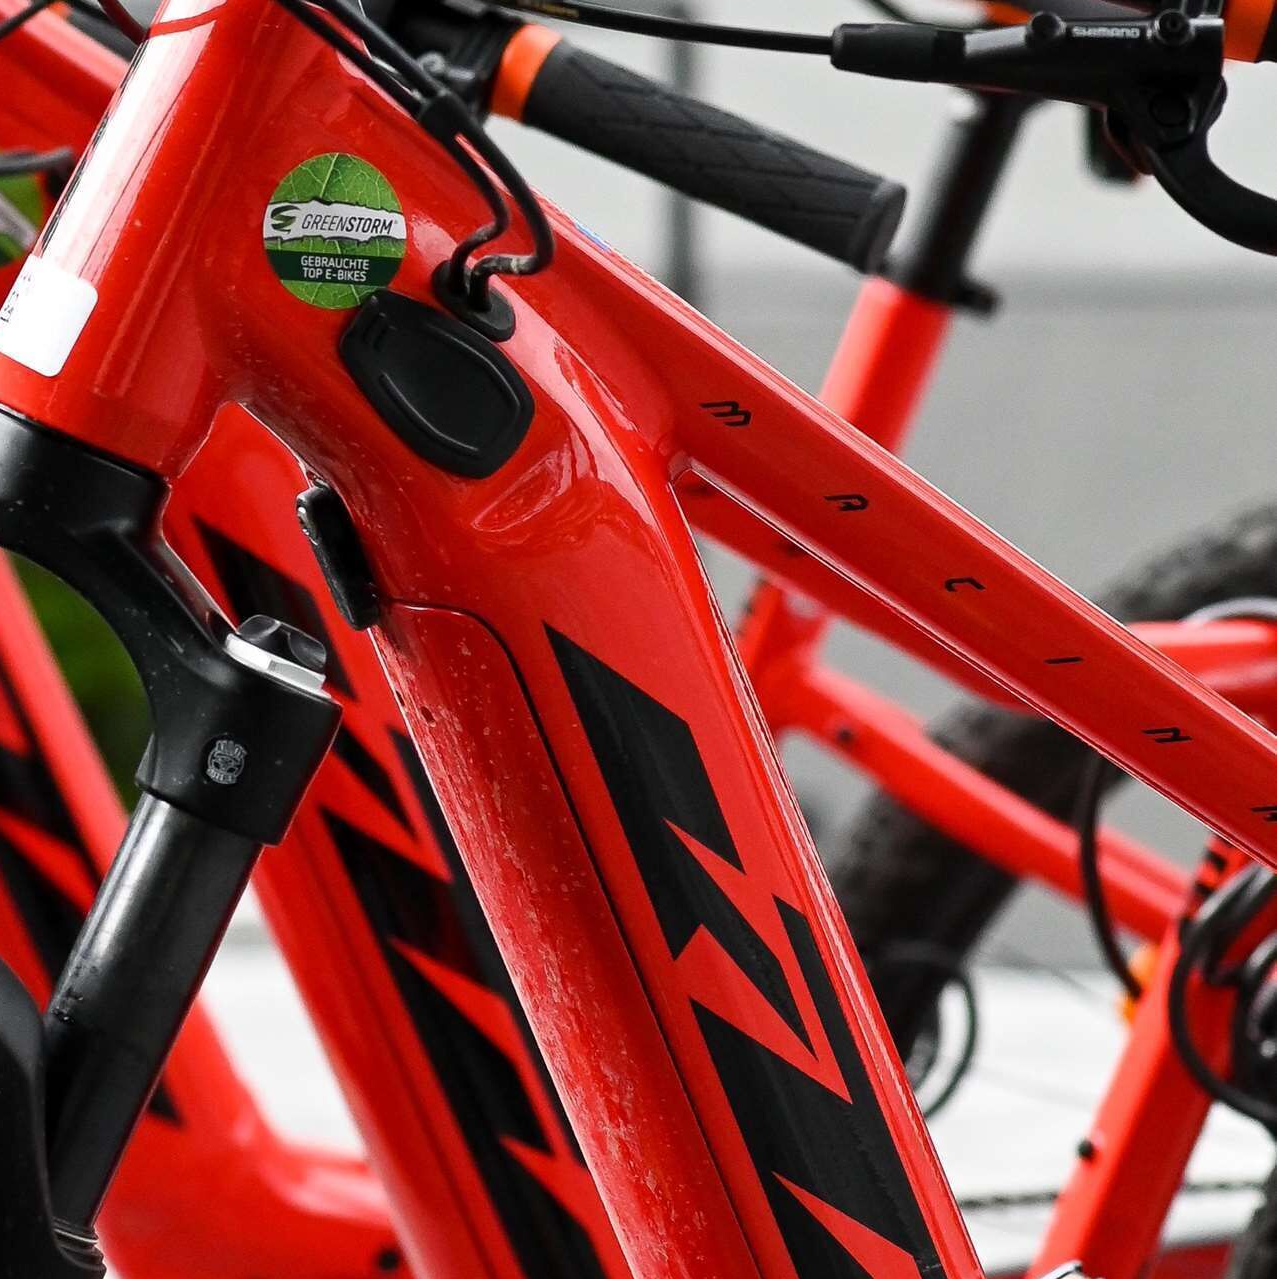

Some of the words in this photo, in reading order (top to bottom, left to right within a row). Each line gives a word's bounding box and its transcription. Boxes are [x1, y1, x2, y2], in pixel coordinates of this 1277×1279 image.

[301, 213, 393, 235] GREENSTORM
[300, 255, 370, 270] GEBRAUCHTE
[302, 267, 323, 279] TOP
[325, 268, 367, 282] E-BIKES
